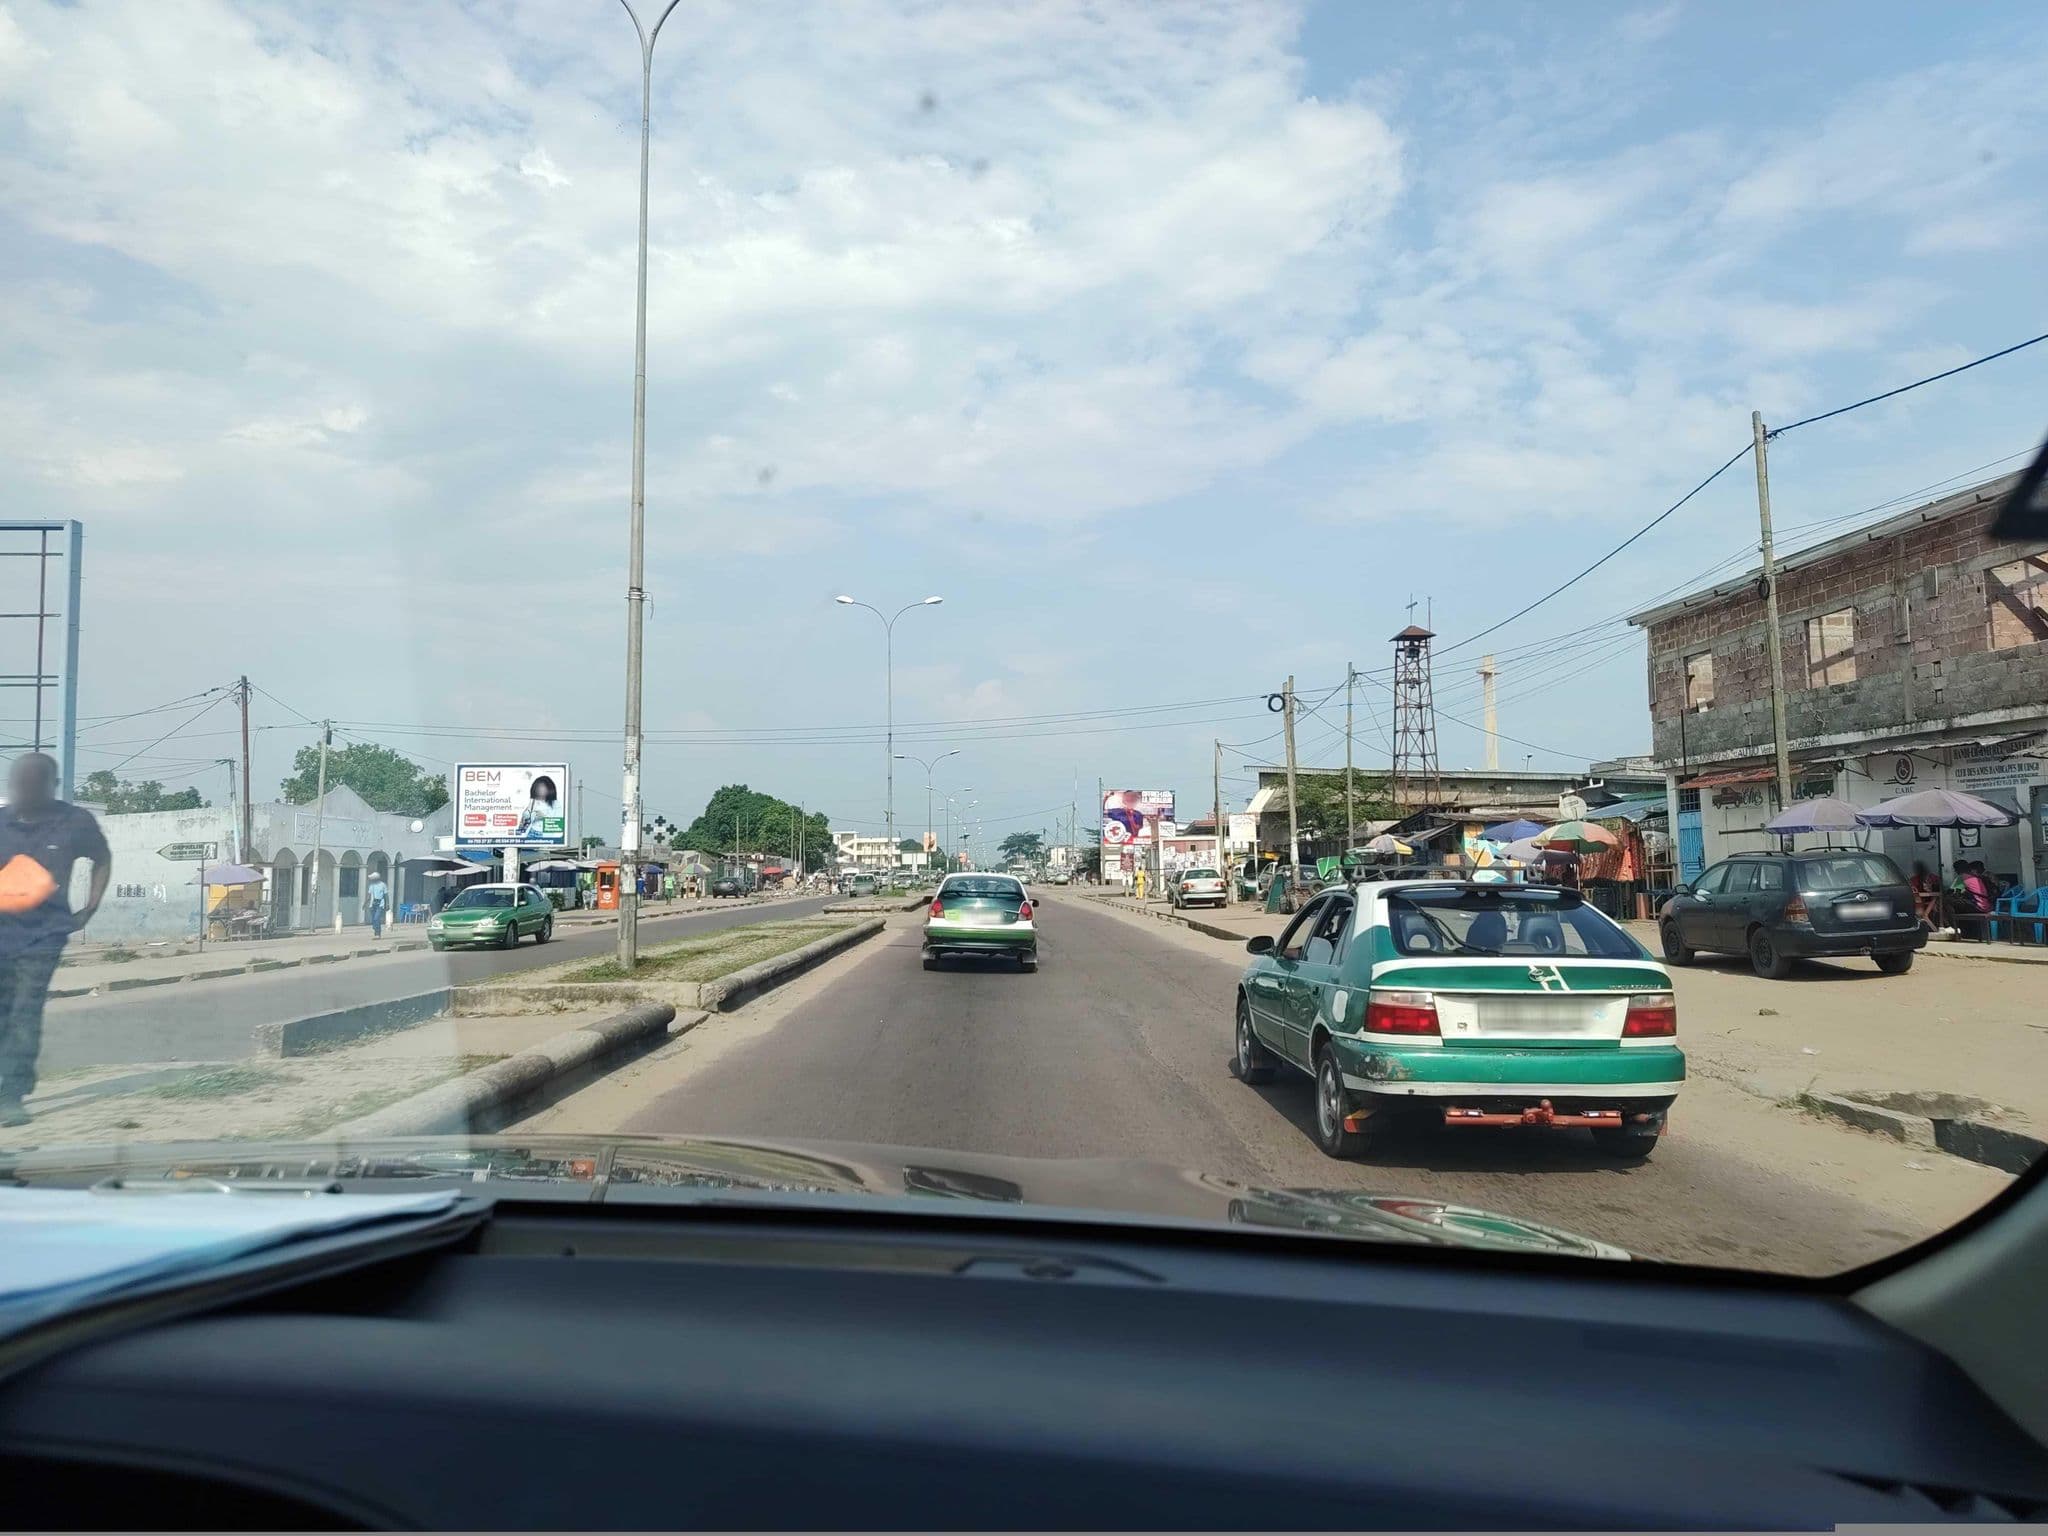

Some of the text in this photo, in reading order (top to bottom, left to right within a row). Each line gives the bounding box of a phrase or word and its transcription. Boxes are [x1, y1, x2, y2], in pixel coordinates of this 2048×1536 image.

[465, 770, 501, 782] BEM
[1967, 767, 1977, 777] DES
[464, 796, 512, 804] International
[464, 804, 512, 813] Management
